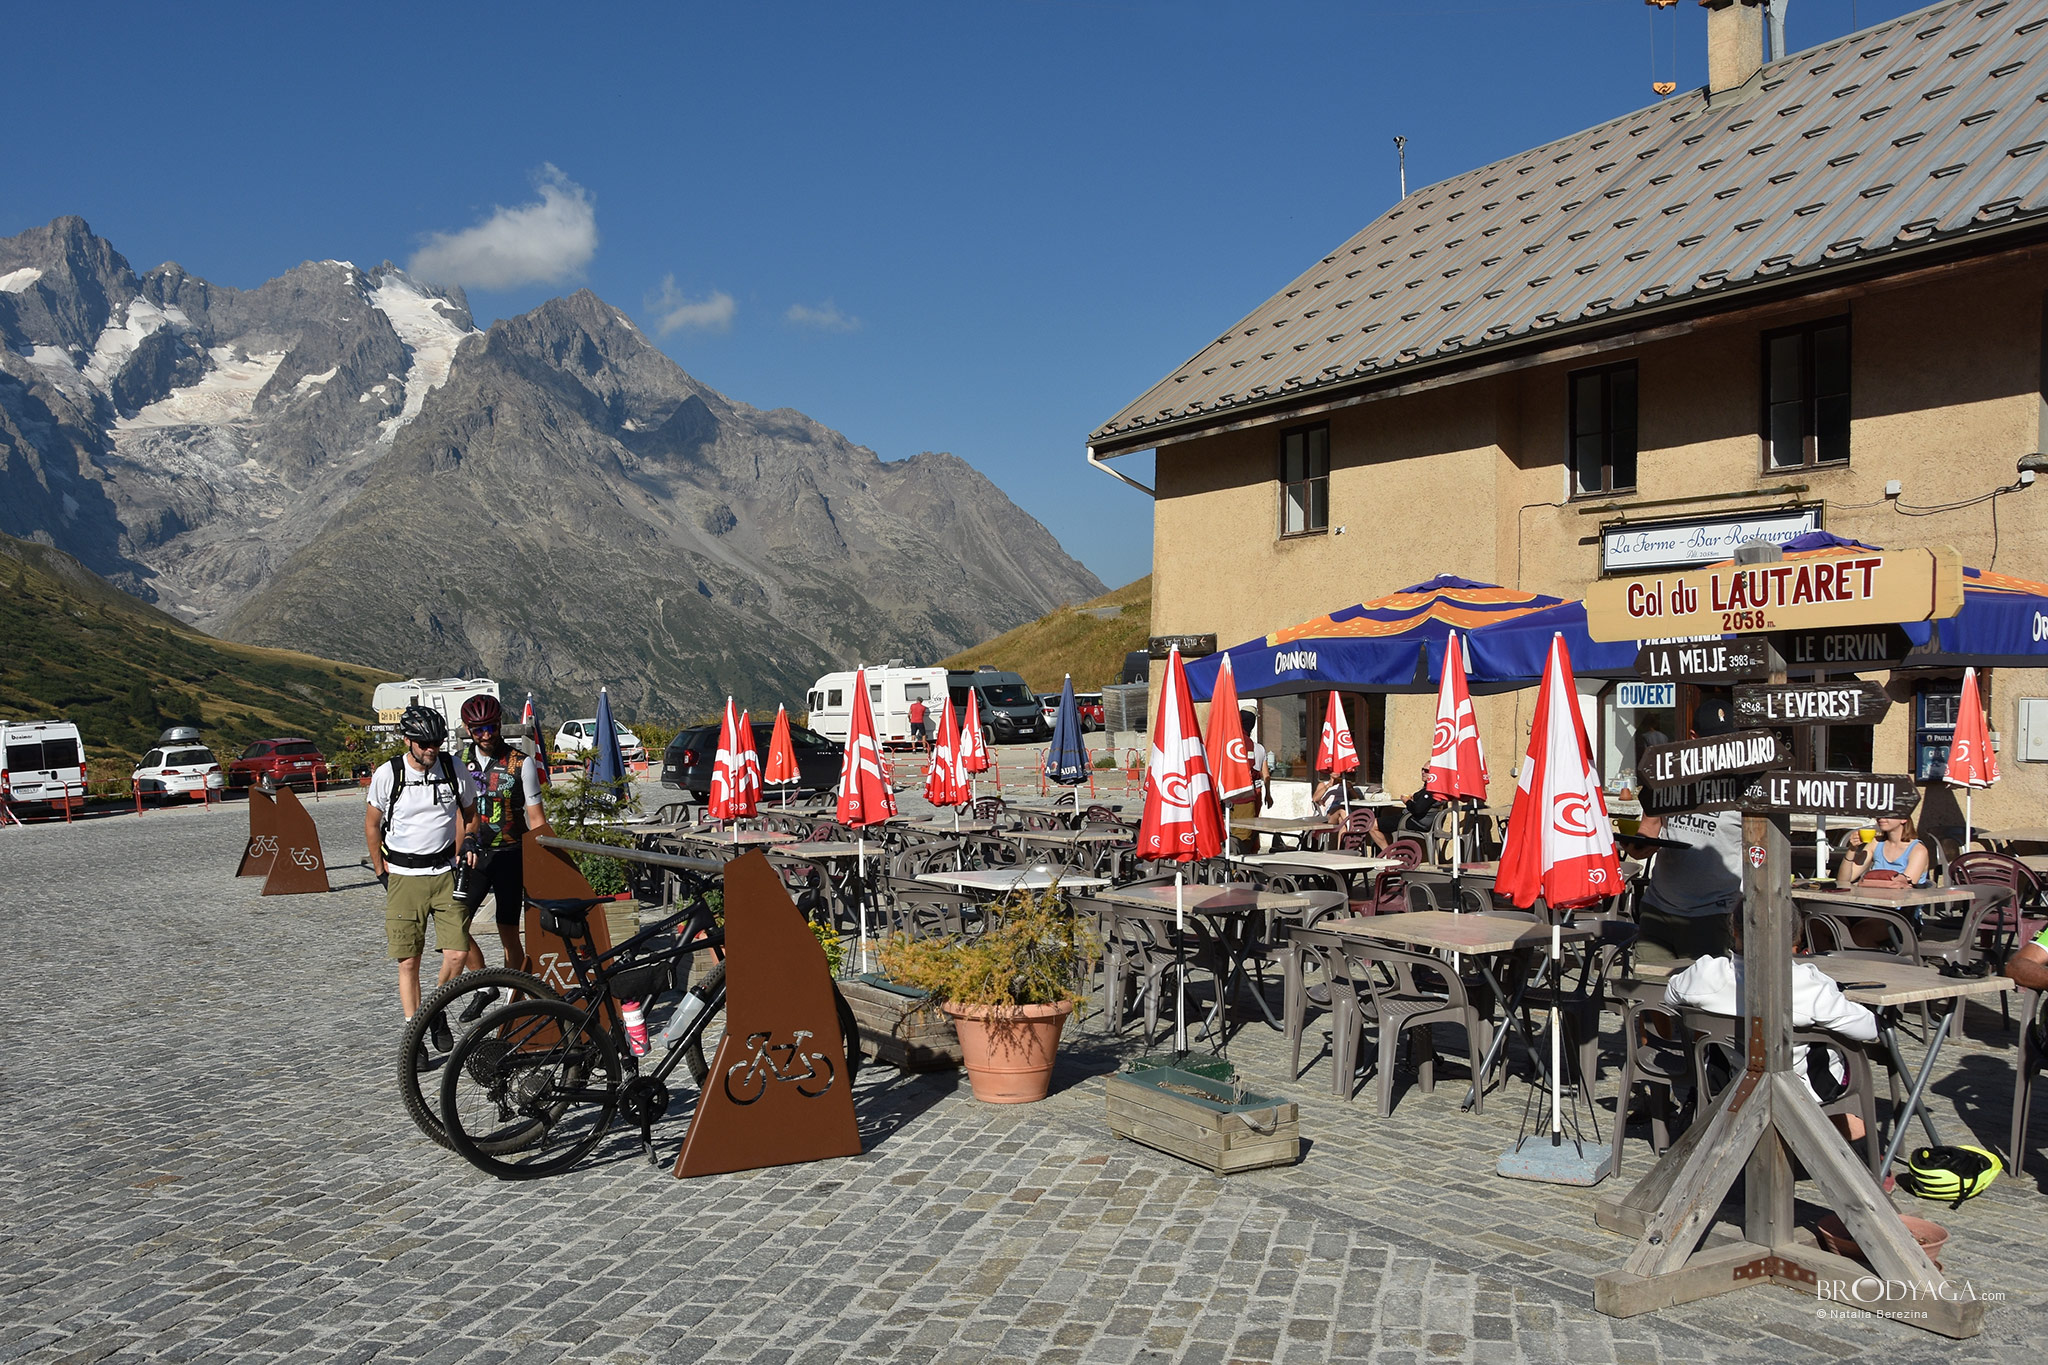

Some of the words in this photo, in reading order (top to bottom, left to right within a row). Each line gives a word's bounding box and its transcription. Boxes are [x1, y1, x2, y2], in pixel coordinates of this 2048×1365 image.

[1609, 534, 1630, 554] La
[1633, 532, 1675, 552] Ferme
[1686, 527, 1721, 549] Bar
[1627, 580, 1663, 618] Col
[1671, 578, 1698, 615] du
[1711, 557, 1883, 612] LAUTARET
[1722, 611, 1765, 631] 2058
[1650, 651, 1672, 677] LA
[1679, 647, 1728, 675] MEIJE
[1795, 636, 1815, 662] LE
[1824, 633, 1887, 662] CERVIN
[1621, 685, 1673, 705] OUVERT
[1767, 689, 1863, 719] L'EVEREST
[1656, 752, 1674, 780] LE
[1680, 736, 1775, 777] KILIMANDJARO
[1652, 784, 1689, 808] MONT
[1770, 778, 1790, 806] LE
[1797, 780, 1848, 808] MONT
[1856, 781, 1895, 811] FUJI
